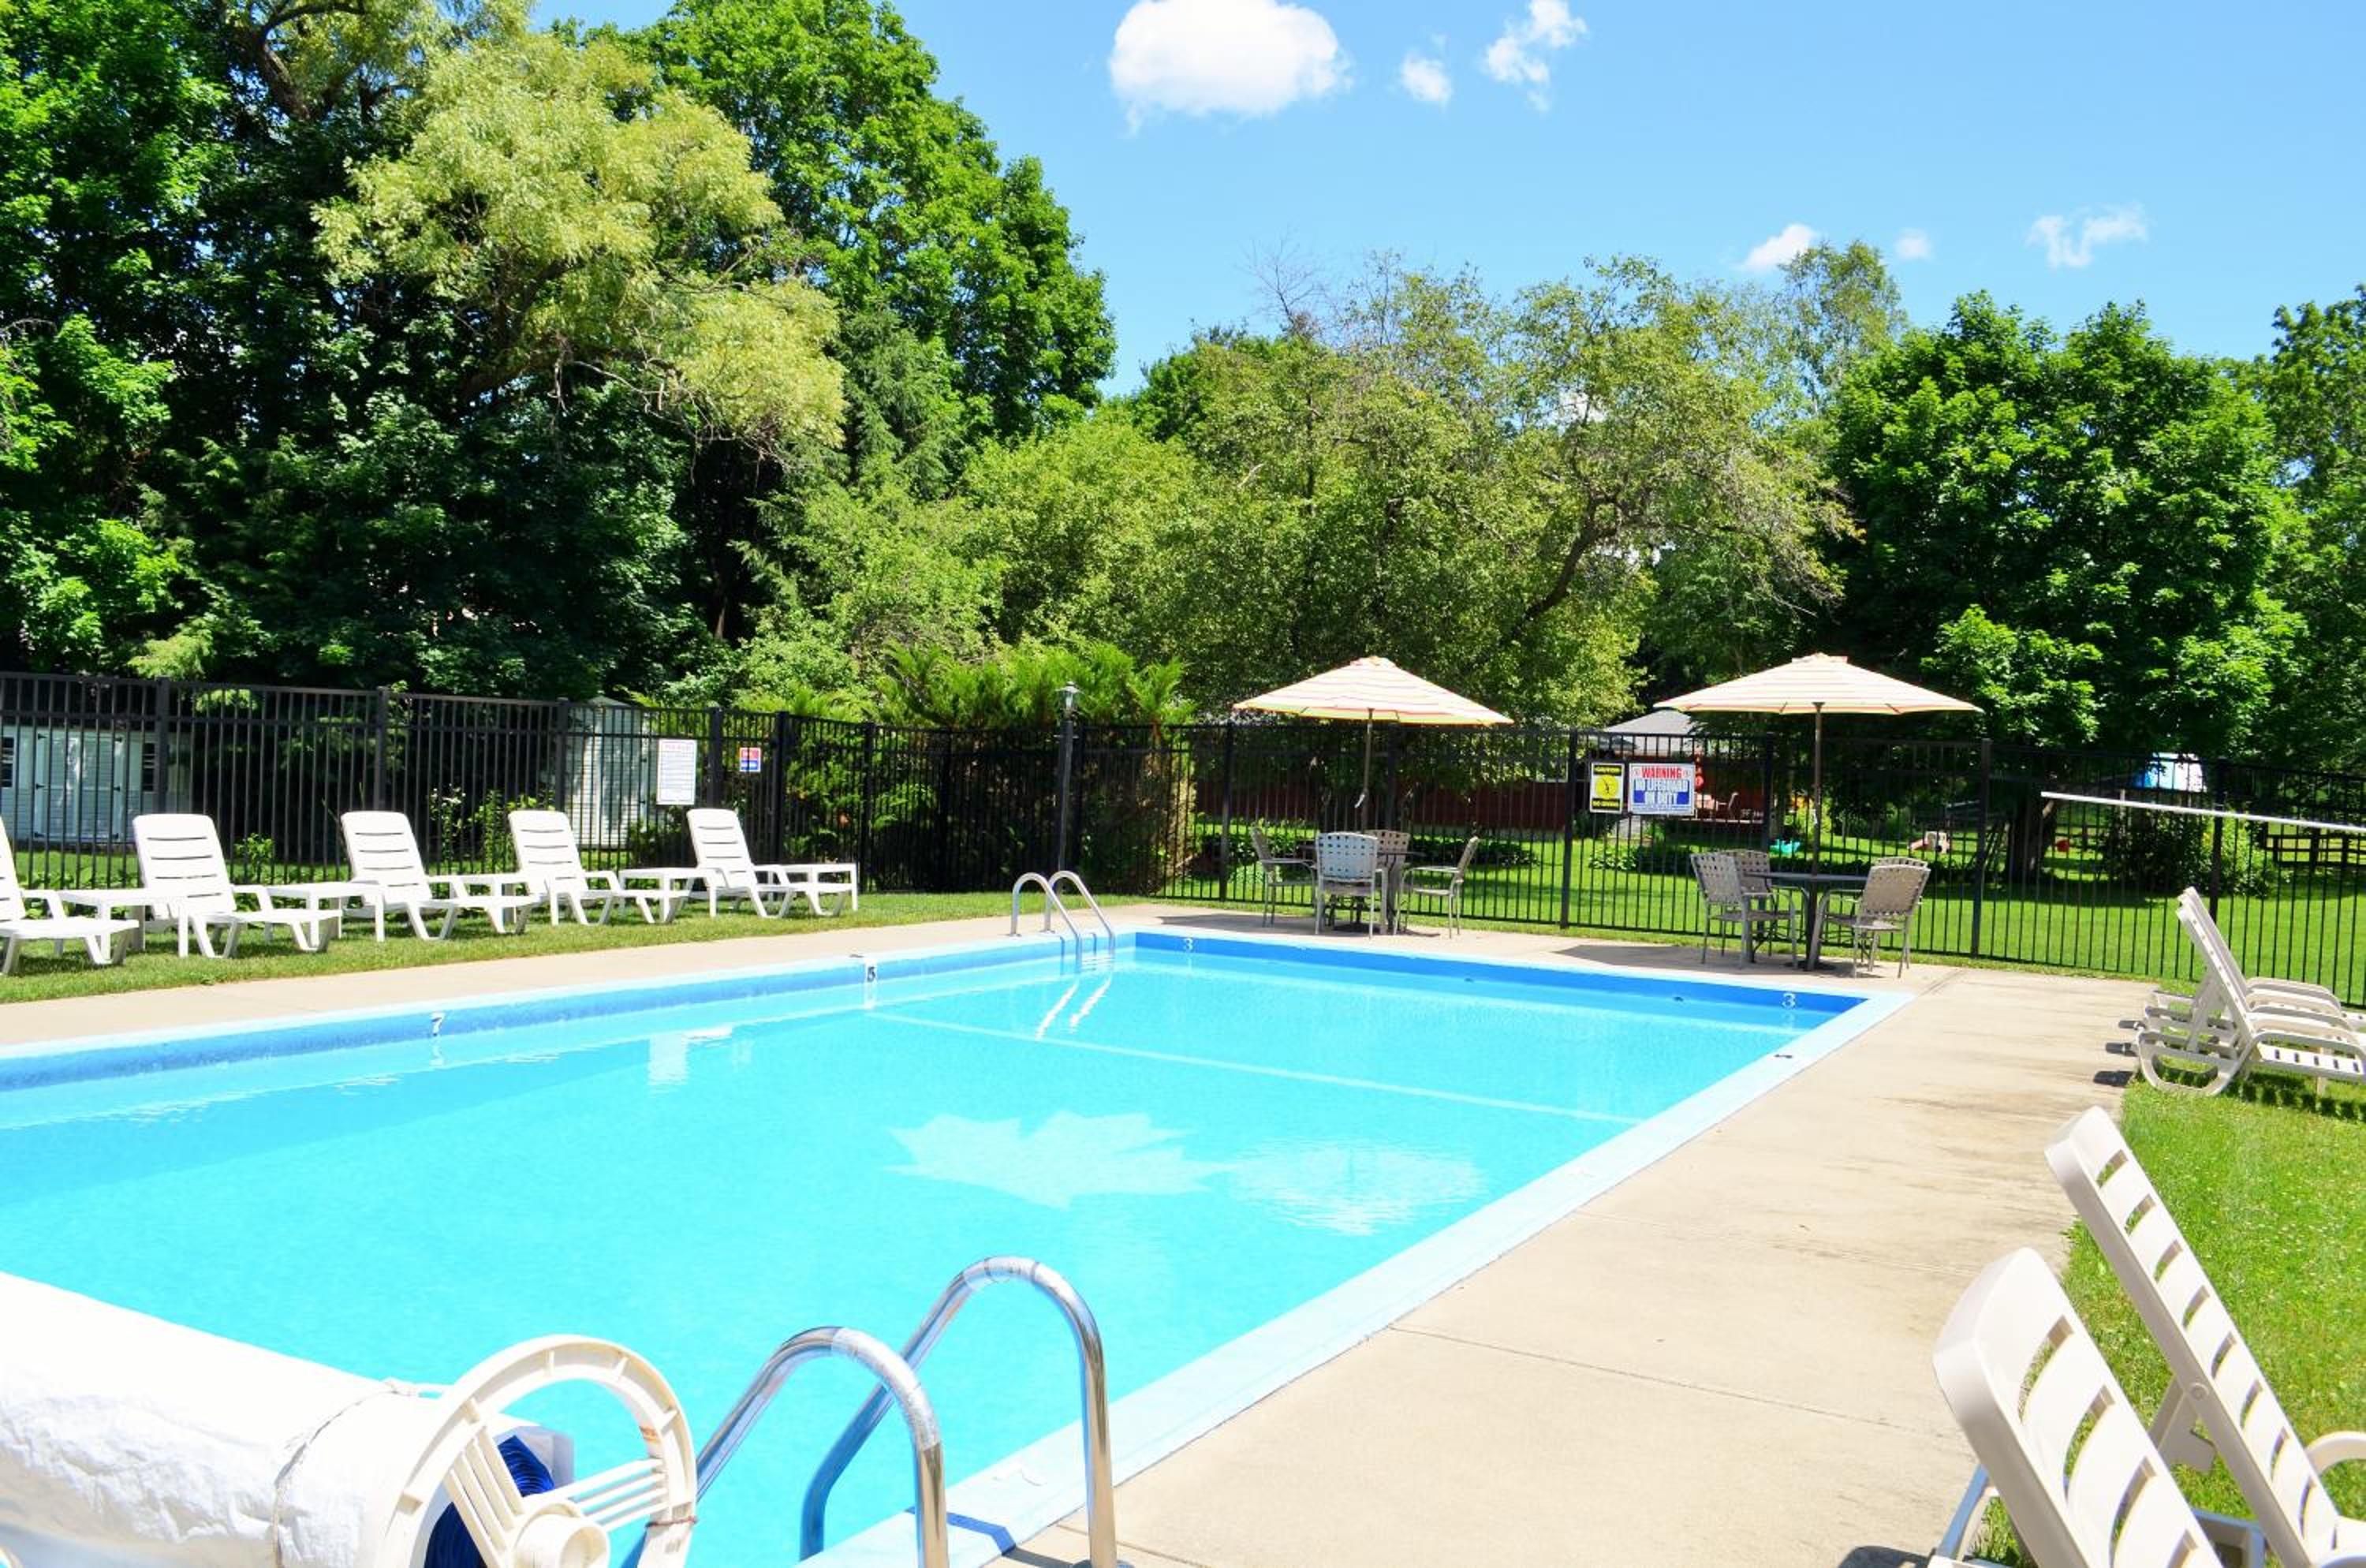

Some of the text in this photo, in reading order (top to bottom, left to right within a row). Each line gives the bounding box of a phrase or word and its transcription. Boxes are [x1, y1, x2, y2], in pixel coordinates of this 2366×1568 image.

[1641, 767, 1683, 778] WARNING
[1635, 778, 1688, 792] NO LIFEGUARD
[867, 966, 875, 982] 5
[1782, 993, 1796, 1010] 3
[430, 1011, 446, 1036] 7
